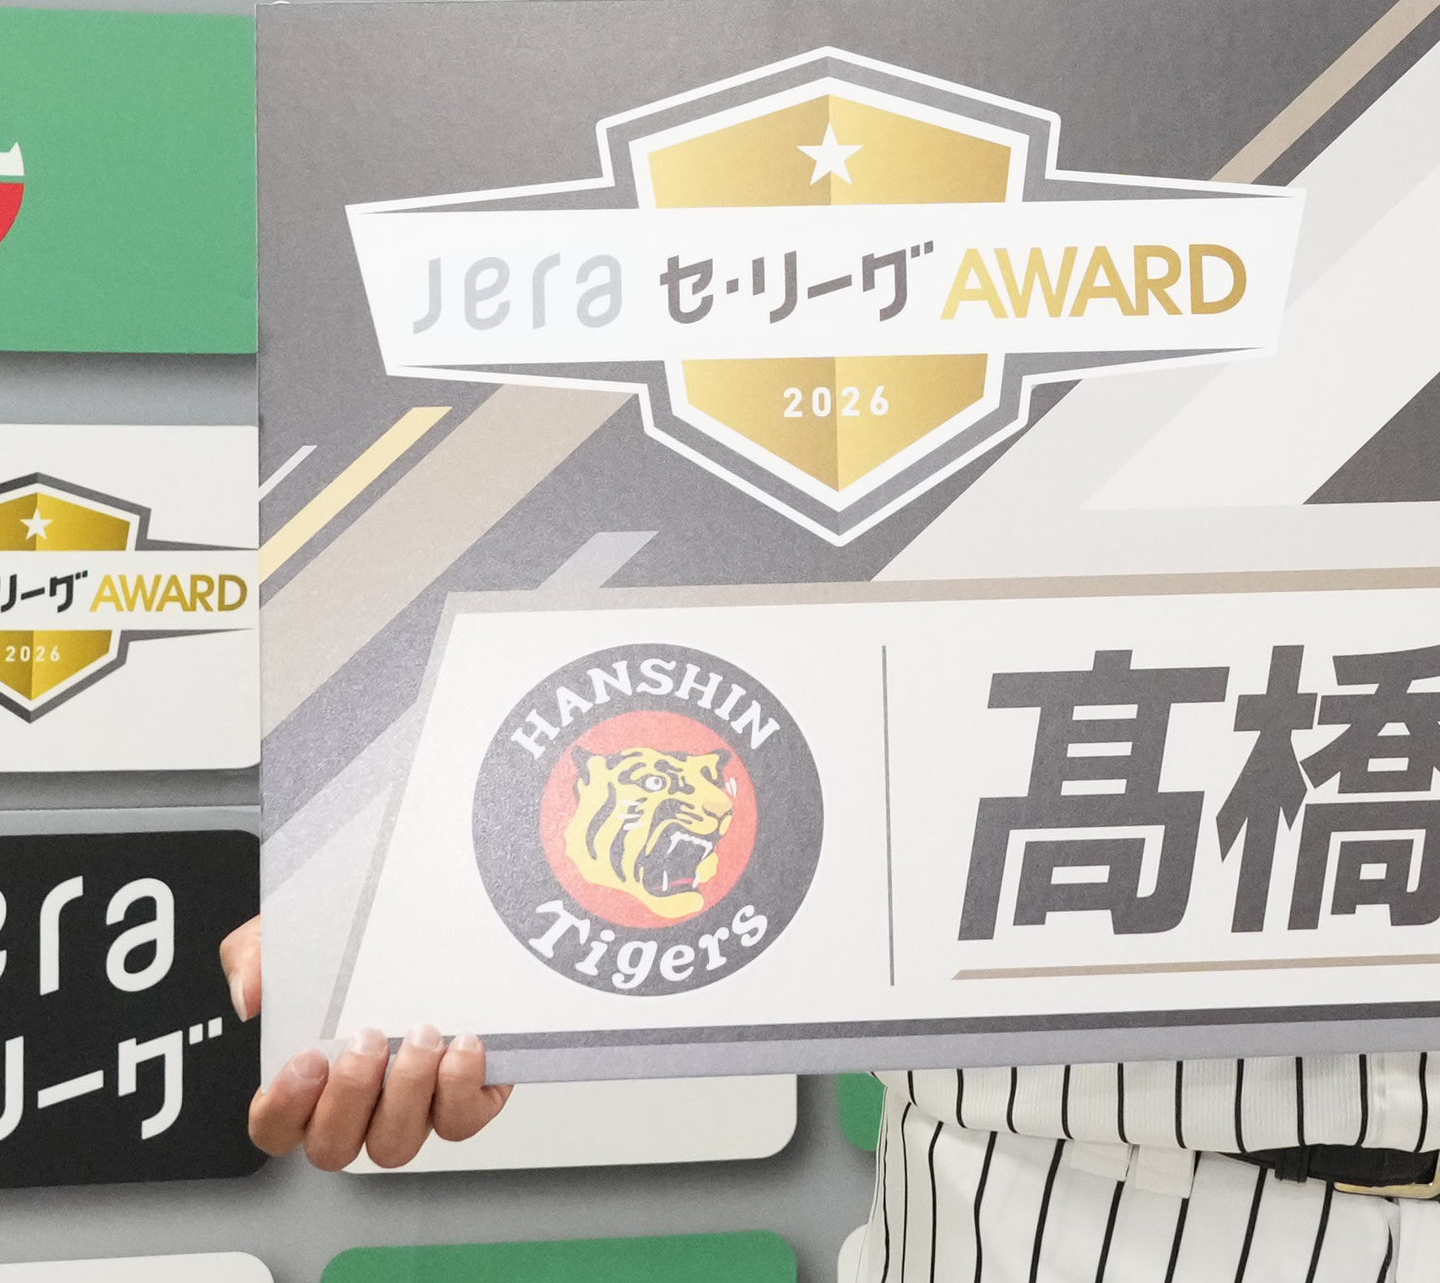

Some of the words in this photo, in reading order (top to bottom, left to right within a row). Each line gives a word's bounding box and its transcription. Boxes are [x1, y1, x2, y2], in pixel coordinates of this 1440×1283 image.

[660, 240, 934, 324] セ・リーグ
[940, 244, 1247, 320] AWARD
[783, 386, 890, 418] 2026
[0, 570, 88, 613] リーグ
[89, 574, 248, 612] AWARD
[5, 646, 60, 662] 2026
[510, 658, 780, 759] HANSHIN
[529, 900, 768, 989] Tigers
